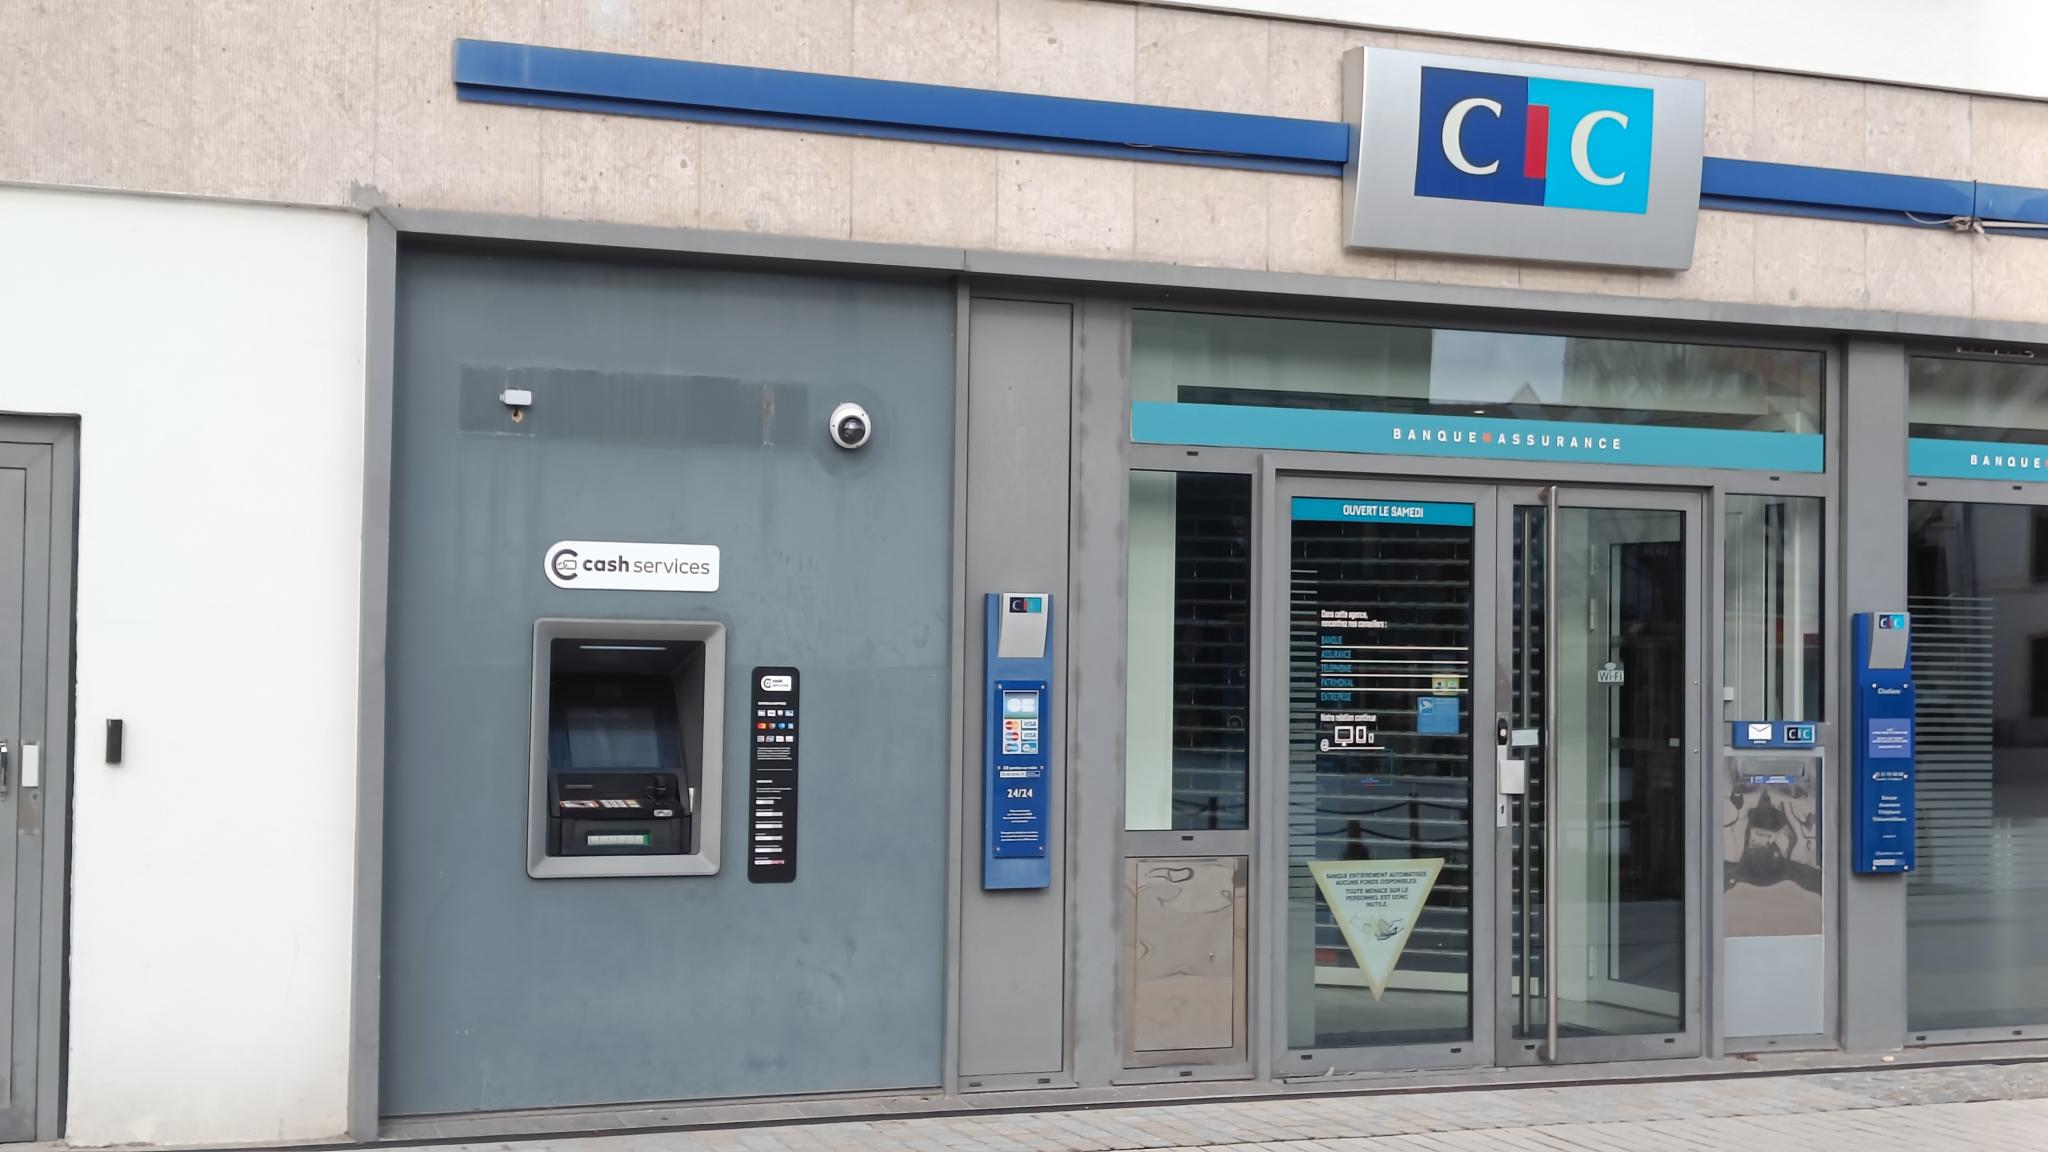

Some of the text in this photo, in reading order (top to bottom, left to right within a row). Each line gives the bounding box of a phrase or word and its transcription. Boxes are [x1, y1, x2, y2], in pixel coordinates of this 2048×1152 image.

[1441, 97, 1629, 186] CIC
[1393, 428, 1621, 450] BANQUE ASSURANCE
[1970, 454, 2041, 468] BANQUE
[1343, 504, 1424, 518] OUVERT LE SAMEDI
[583, 555, 629, 573] cash
[633, 558, 710, 575] services
[1788, 728, 1811, 740] CIC
[1007, 788, 1033, 798] 24/24
